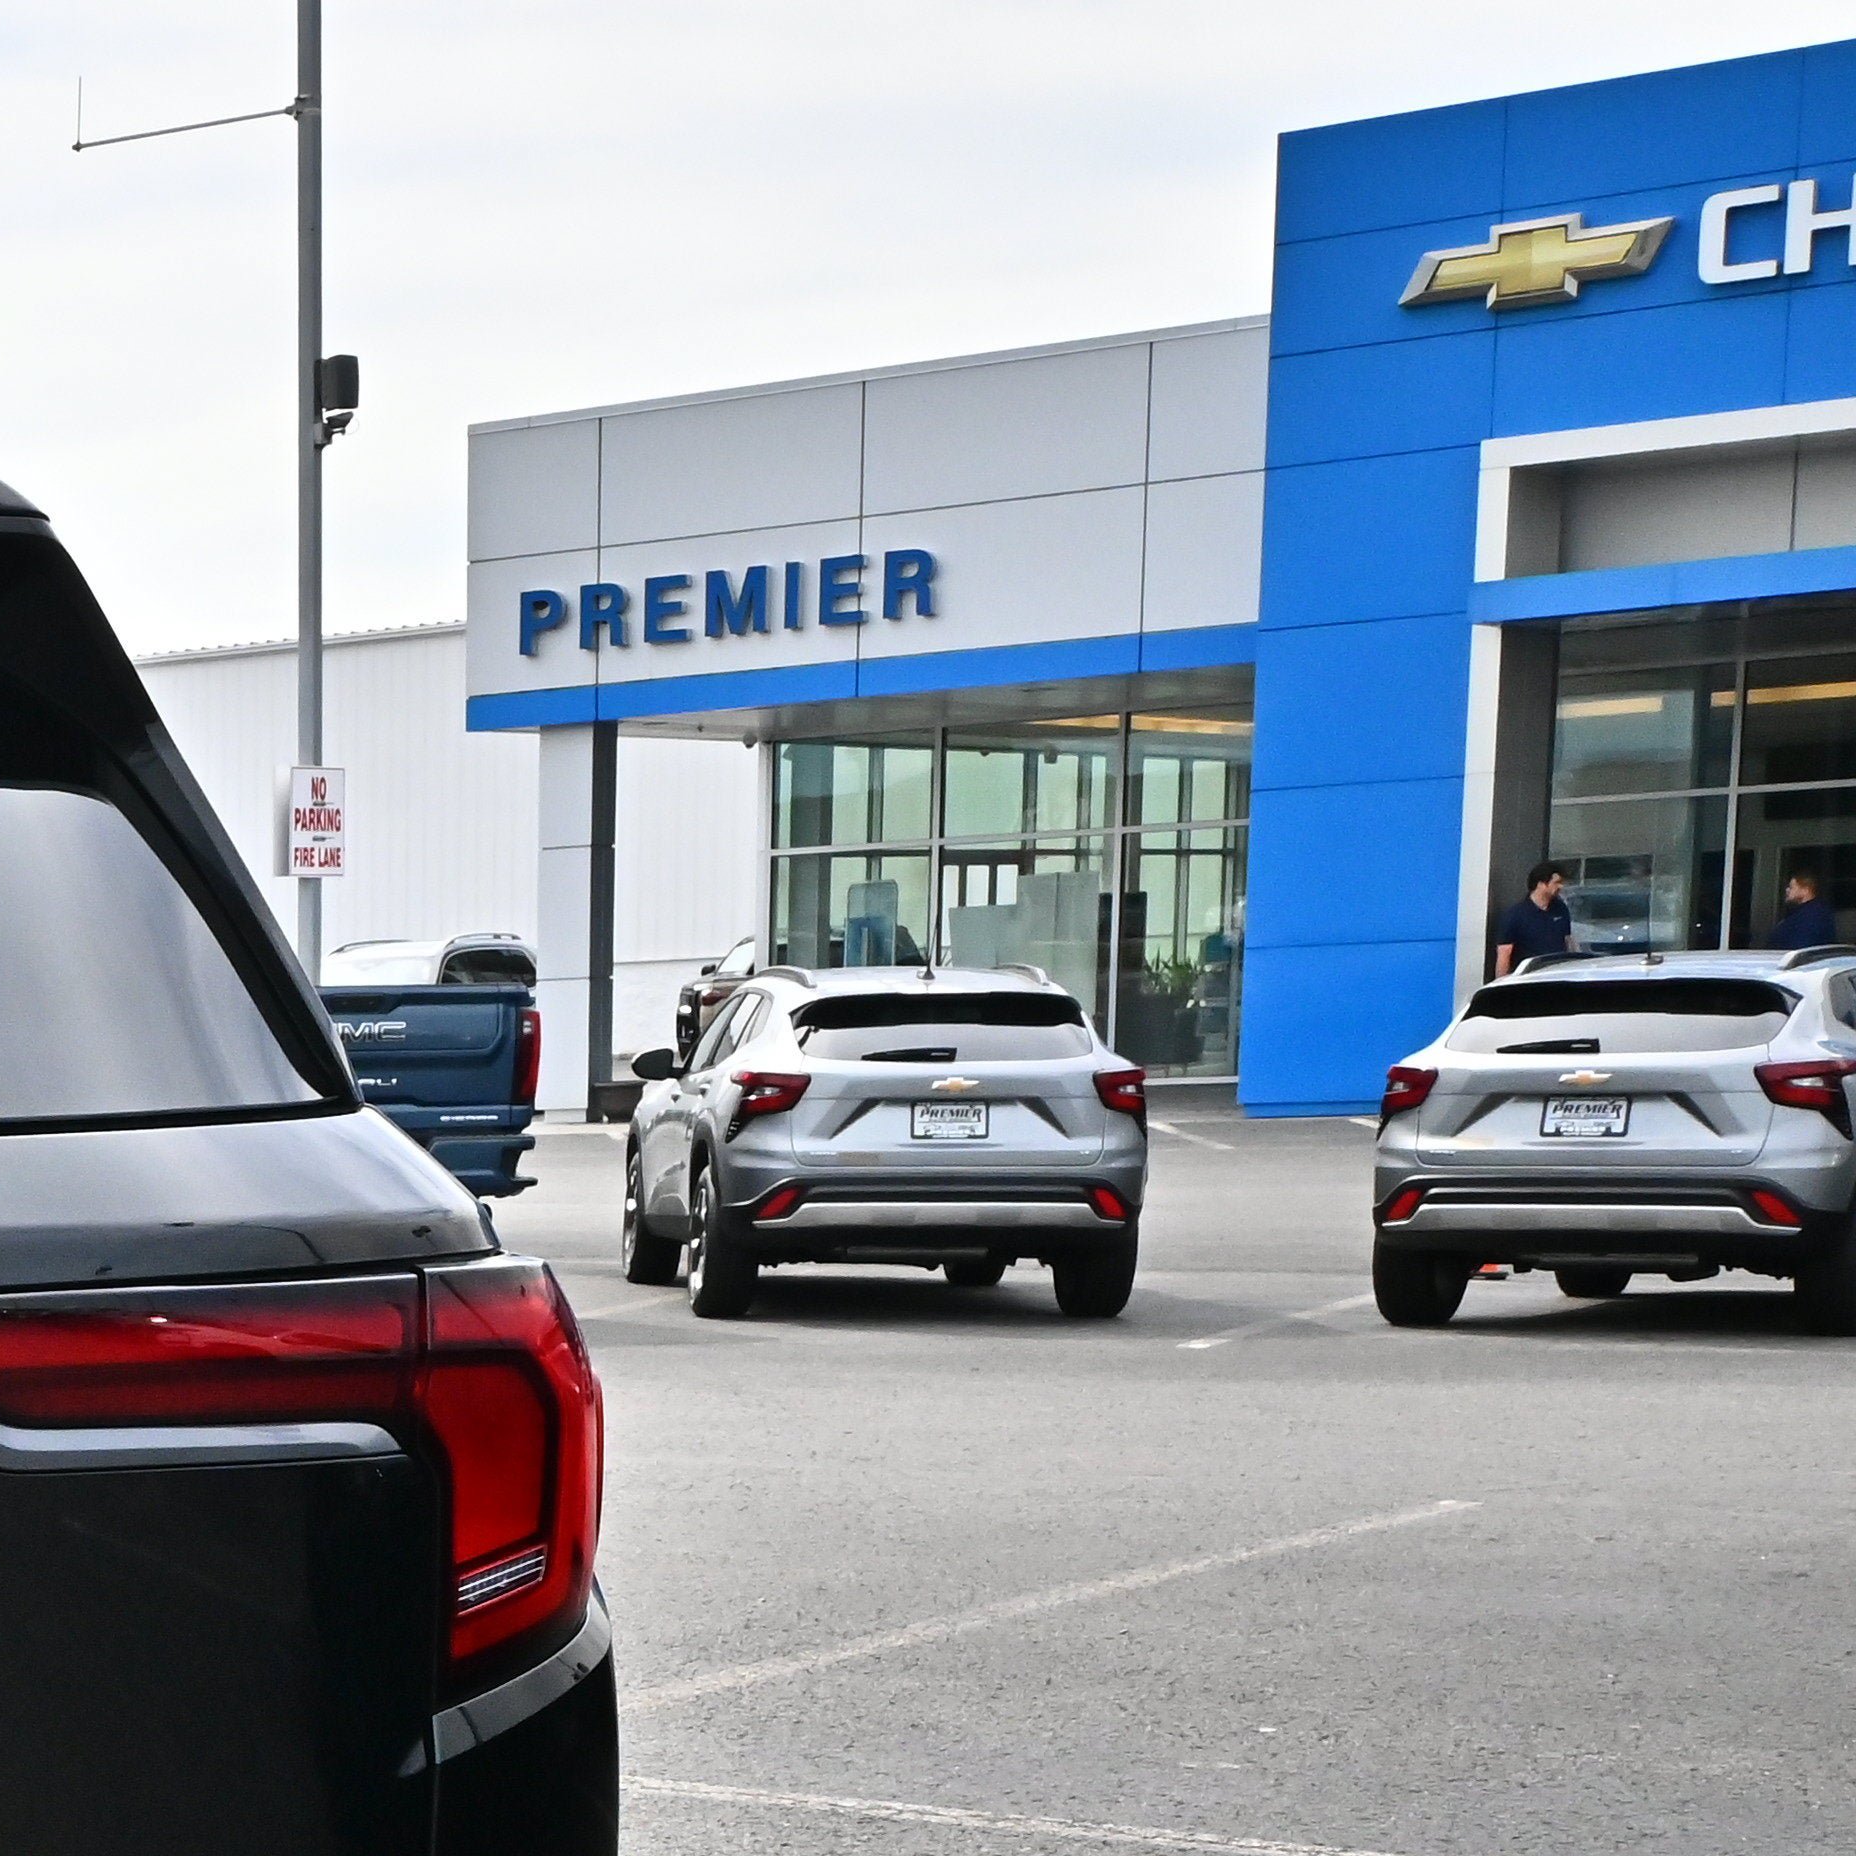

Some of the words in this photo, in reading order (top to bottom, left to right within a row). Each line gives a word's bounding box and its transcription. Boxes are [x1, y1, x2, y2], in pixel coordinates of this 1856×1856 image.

[1698, 173, 1856, 285] CH
[519, 549, 938, 657] PREMIER
[311, 777, 327, 801] NO
[294, 807, 341, 832] PARKING
[294, 847, 315, 867] FIRE
[318, 847, 341, 868] LANE
[338, 1022, 406, 1043] MC
[920, 1108, 982, 1122] PREMIER
[1553, 1104, 1623, 1119] PREMIER
